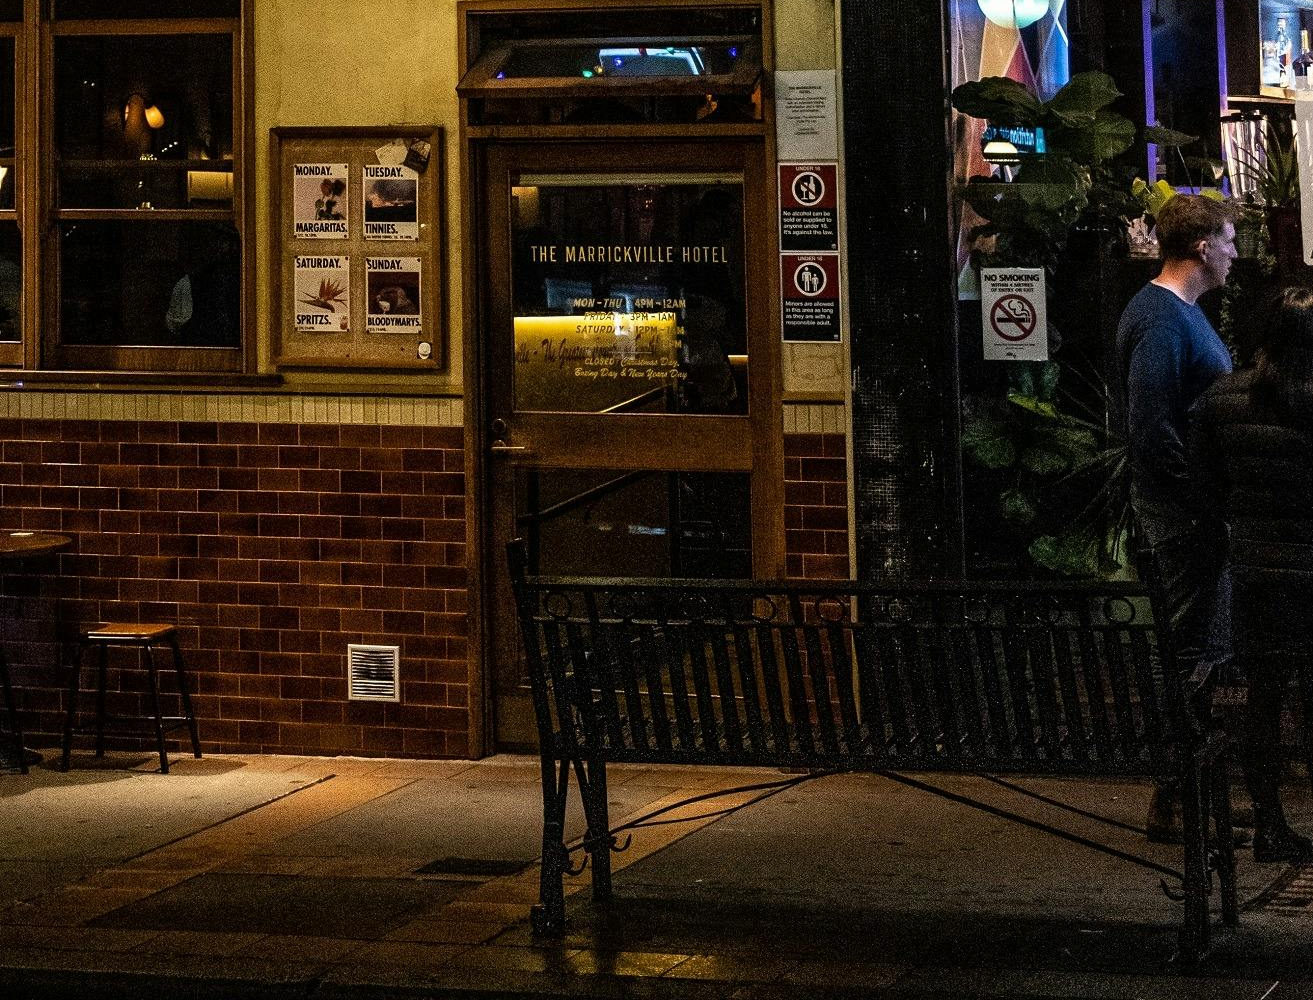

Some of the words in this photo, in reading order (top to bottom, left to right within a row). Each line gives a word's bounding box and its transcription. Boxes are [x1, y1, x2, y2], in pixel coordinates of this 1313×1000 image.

[295, 166, 332, 176] MONDAY.
[365, 167, 403, 177] TUESDAY.
[296, 223, 347, 232] MARGARITAS.
[365, 223, 398, 234] TINNIES.
[530, 245, 557, 262] THE
[565, 246, 673, 262] MARRICKVILLE
[682, 246, 728, 263] HOTEL
[296, 258, 341, 268] SATURDAY.
[367, 260, 402, 270] SUNDAY.
[984, 274, 997, 282] NO
[999, 274, 1039, 282] SMOKING
[296, 315, 331, 325] SPRITZS.
[368, 317, 421, 326] BLOODYMARYS.
[630, 312, 648, 321] 3PM
[574, 368, 598, 380] Boxing
[600, 368, 618, 379] Day
[620, 368, 626, 377] &
[628, 368, 644, 377] New
[670, 369, 688, 380] Day
